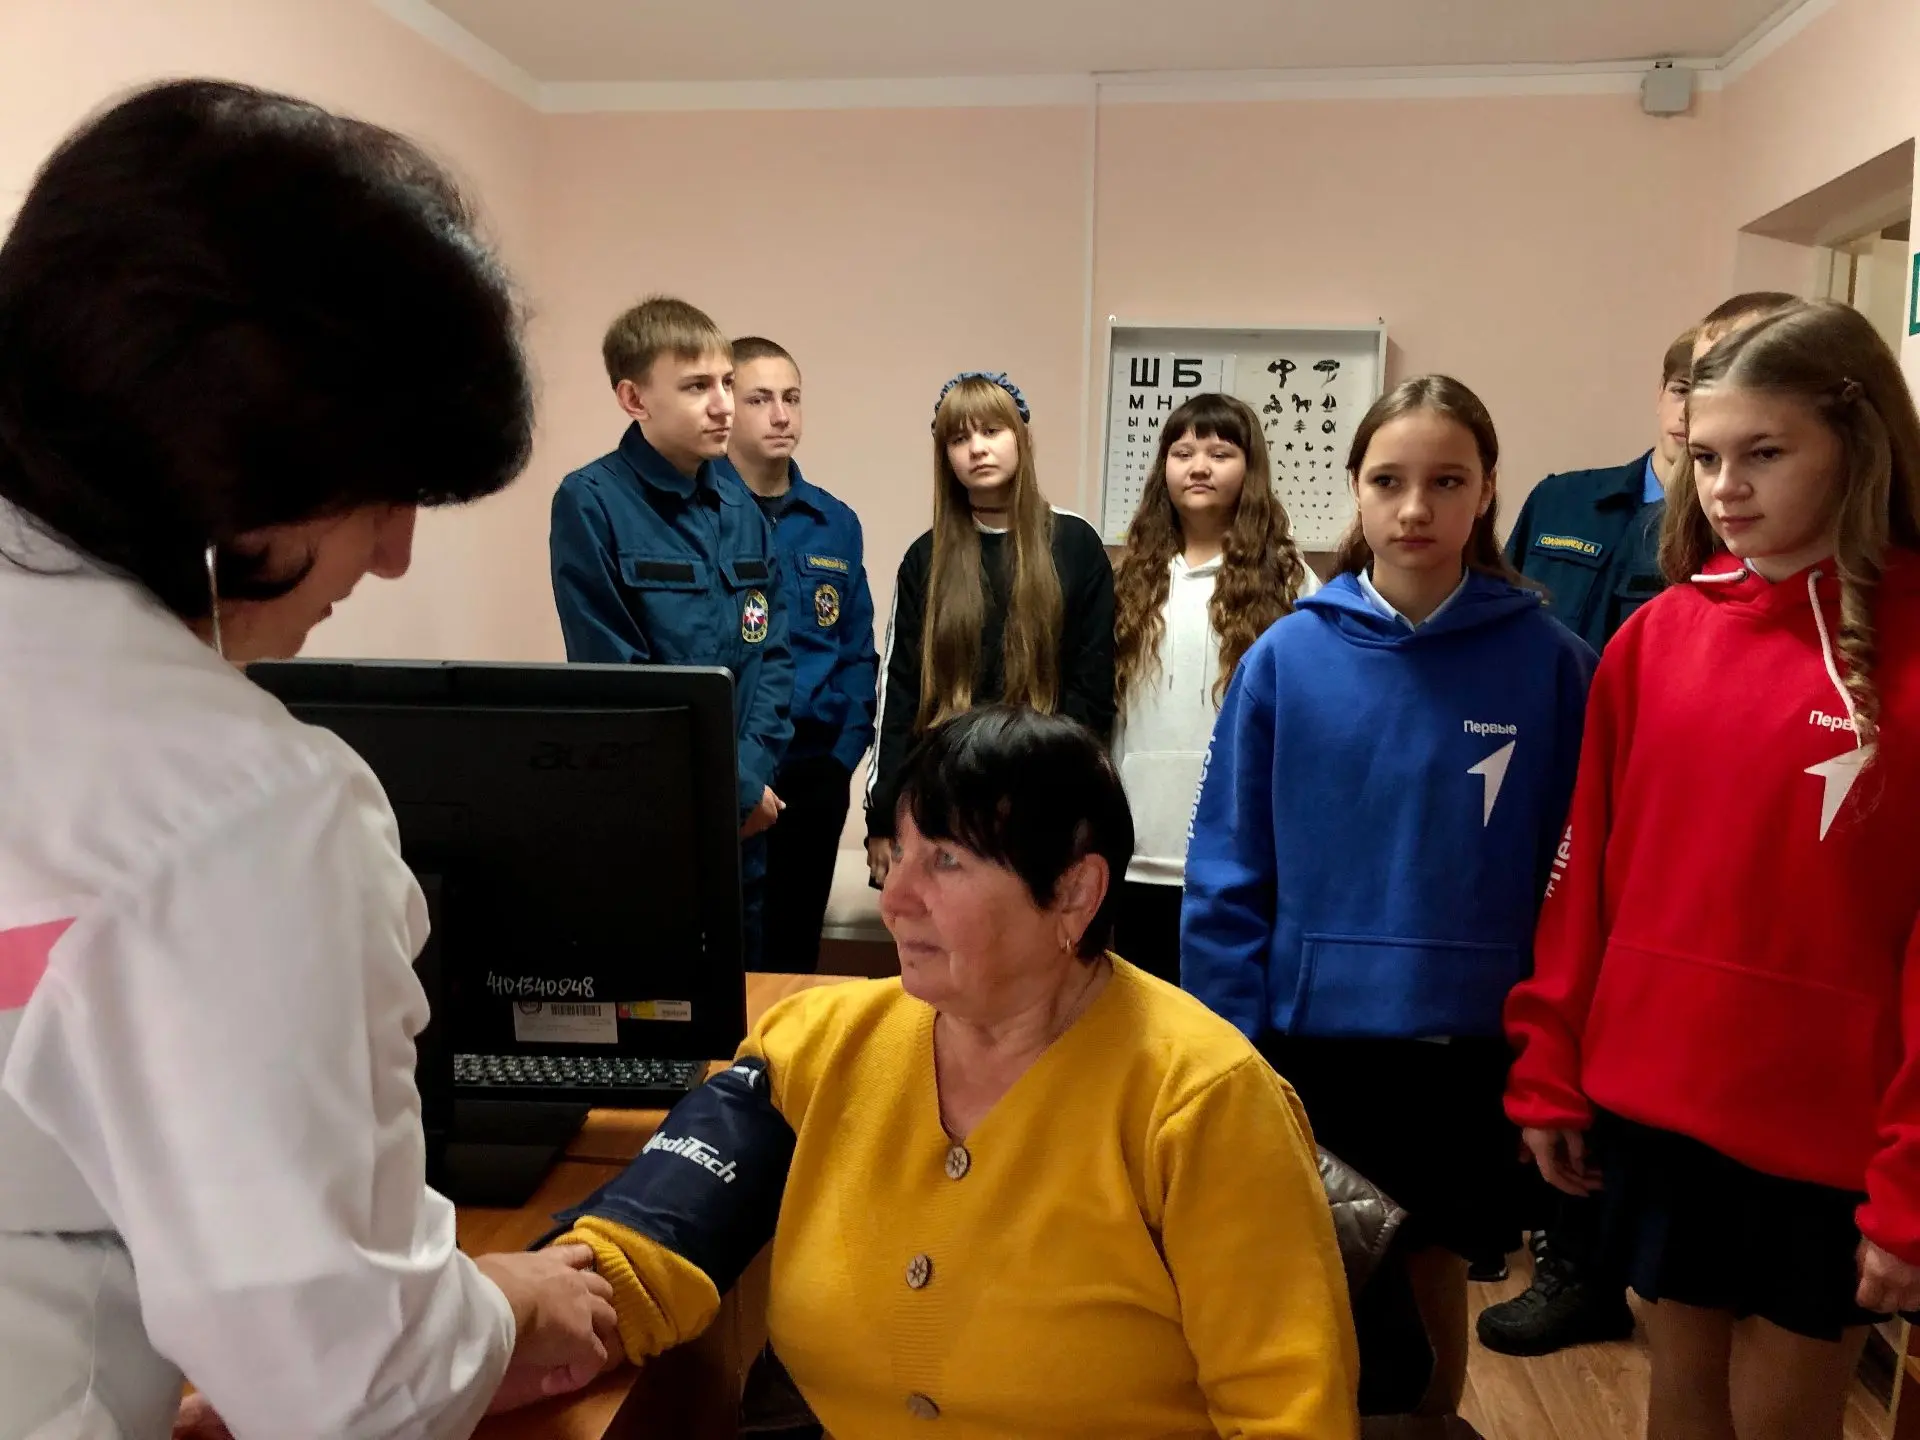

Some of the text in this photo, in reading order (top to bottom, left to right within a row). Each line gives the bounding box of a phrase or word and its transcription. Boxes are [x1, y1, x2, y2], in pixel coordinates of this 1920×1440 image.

[1130, 358, 1203, 388] Ш Б
[1129, 394, 1144, 410] М
[1157, 395, 1172, 410] Н
[1128, 416, 1158, 427] Ы М
[1463, 719, 1517, 737] Первые
